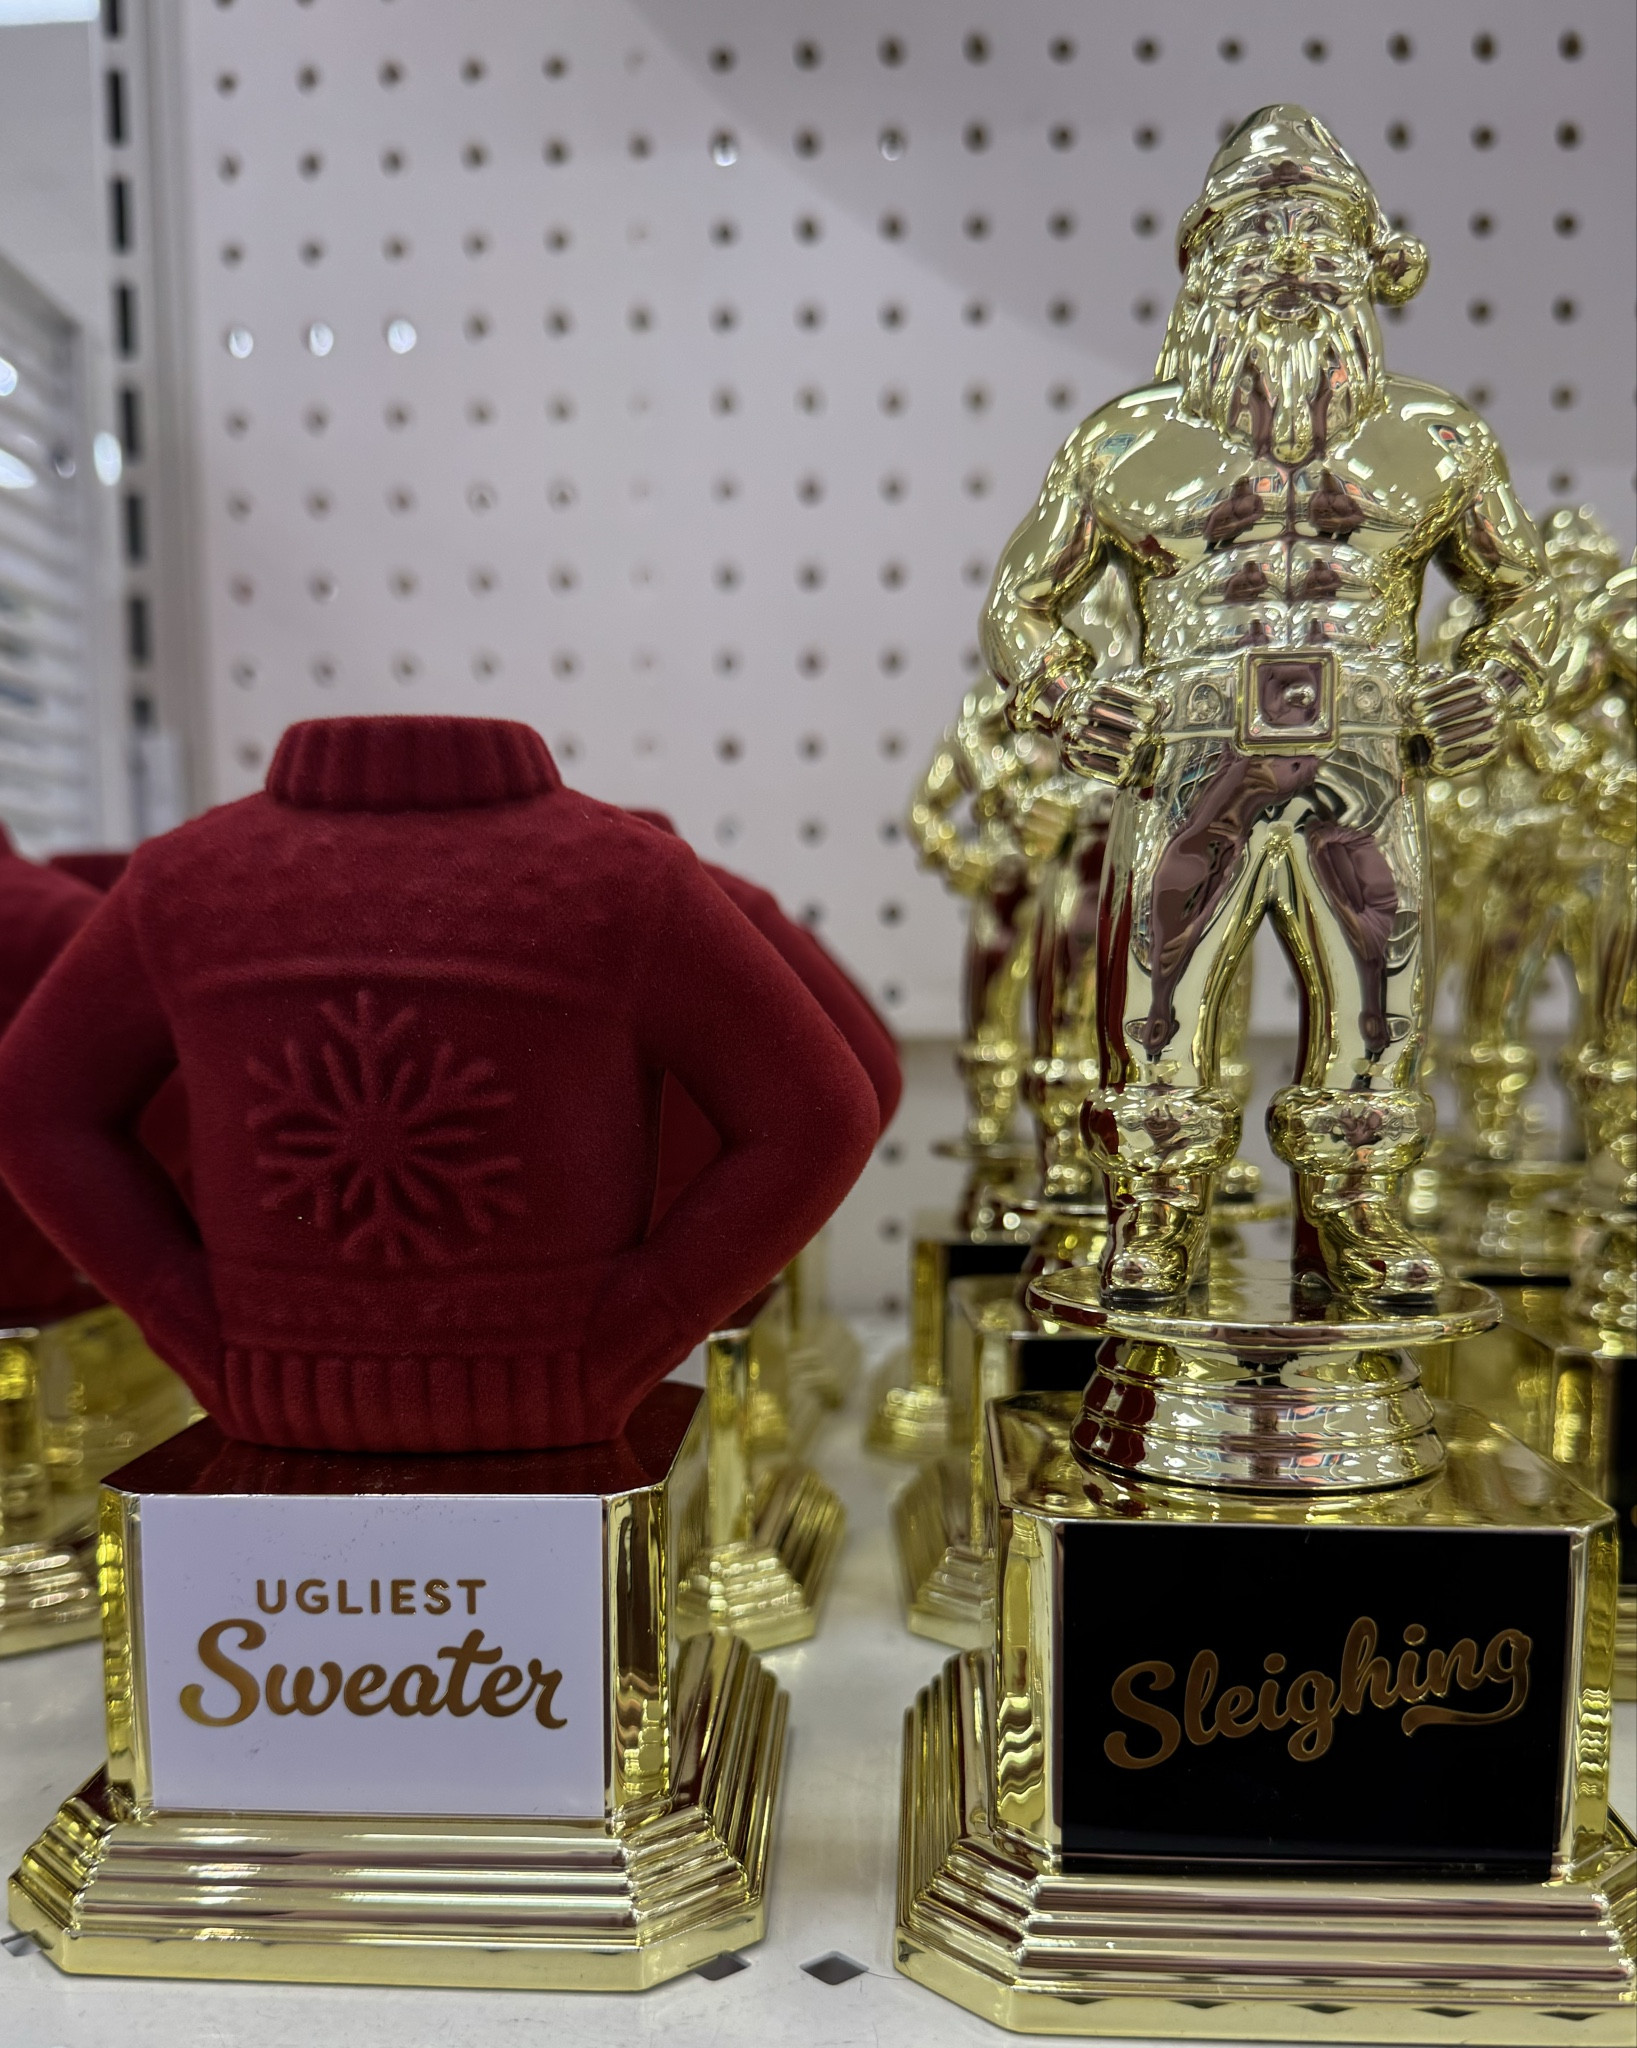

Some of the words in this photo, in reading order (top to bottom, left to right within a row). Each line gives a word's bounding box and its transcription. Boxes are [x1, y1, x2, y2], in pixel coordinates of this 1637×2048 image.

[256, 1578, 487, 1616] UGLIEST
[179, 1618, 568, 1730] Sweater
[1103, 1615, 1533, 1770] Sleighing
